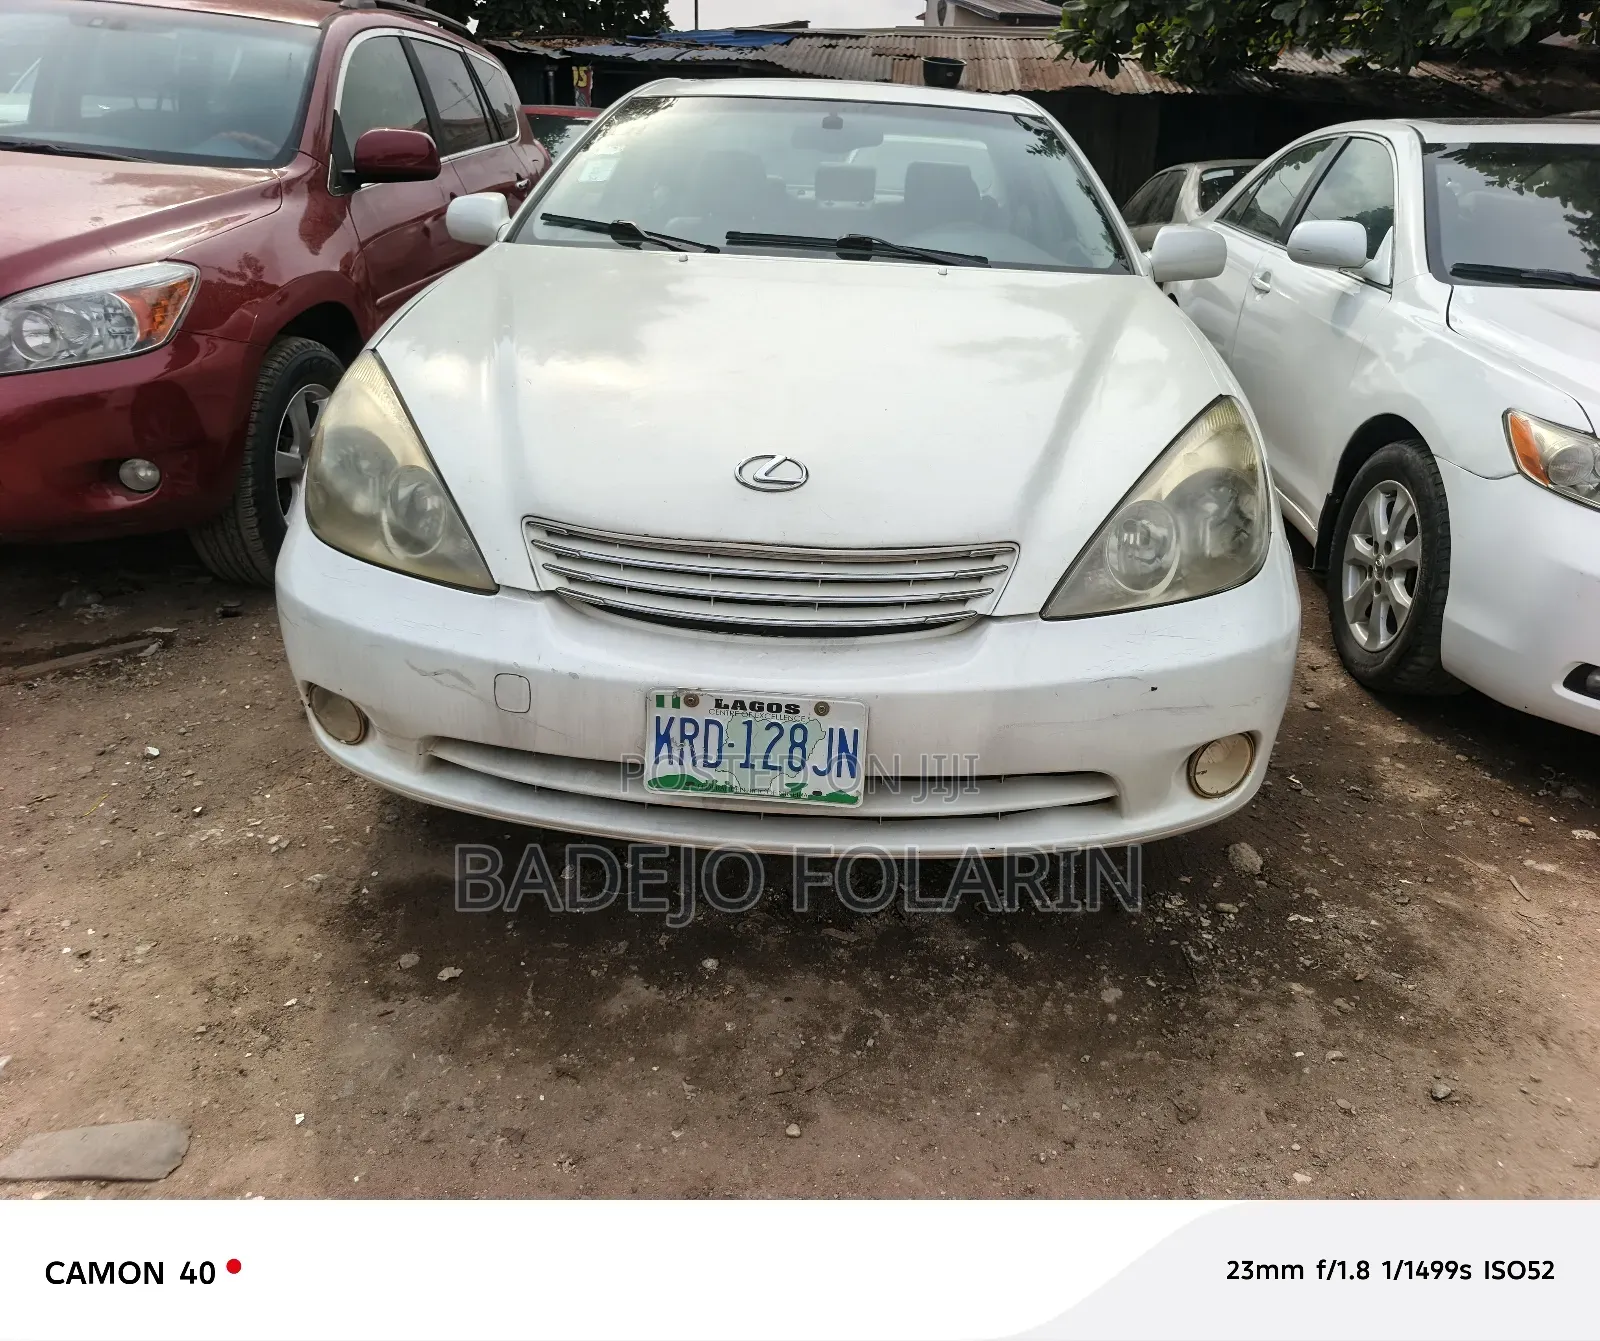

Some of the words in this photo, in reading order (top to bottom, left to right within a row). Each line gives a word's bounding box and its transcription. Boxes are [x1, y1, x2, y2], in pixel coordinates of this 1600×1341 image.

[714, 698, 801, 715] LAGOS
[708, 708, 741, 718] CENTRE
[741, 711, 753, 719] OF
[754, 712, 806, 722] EXCELLENCE
